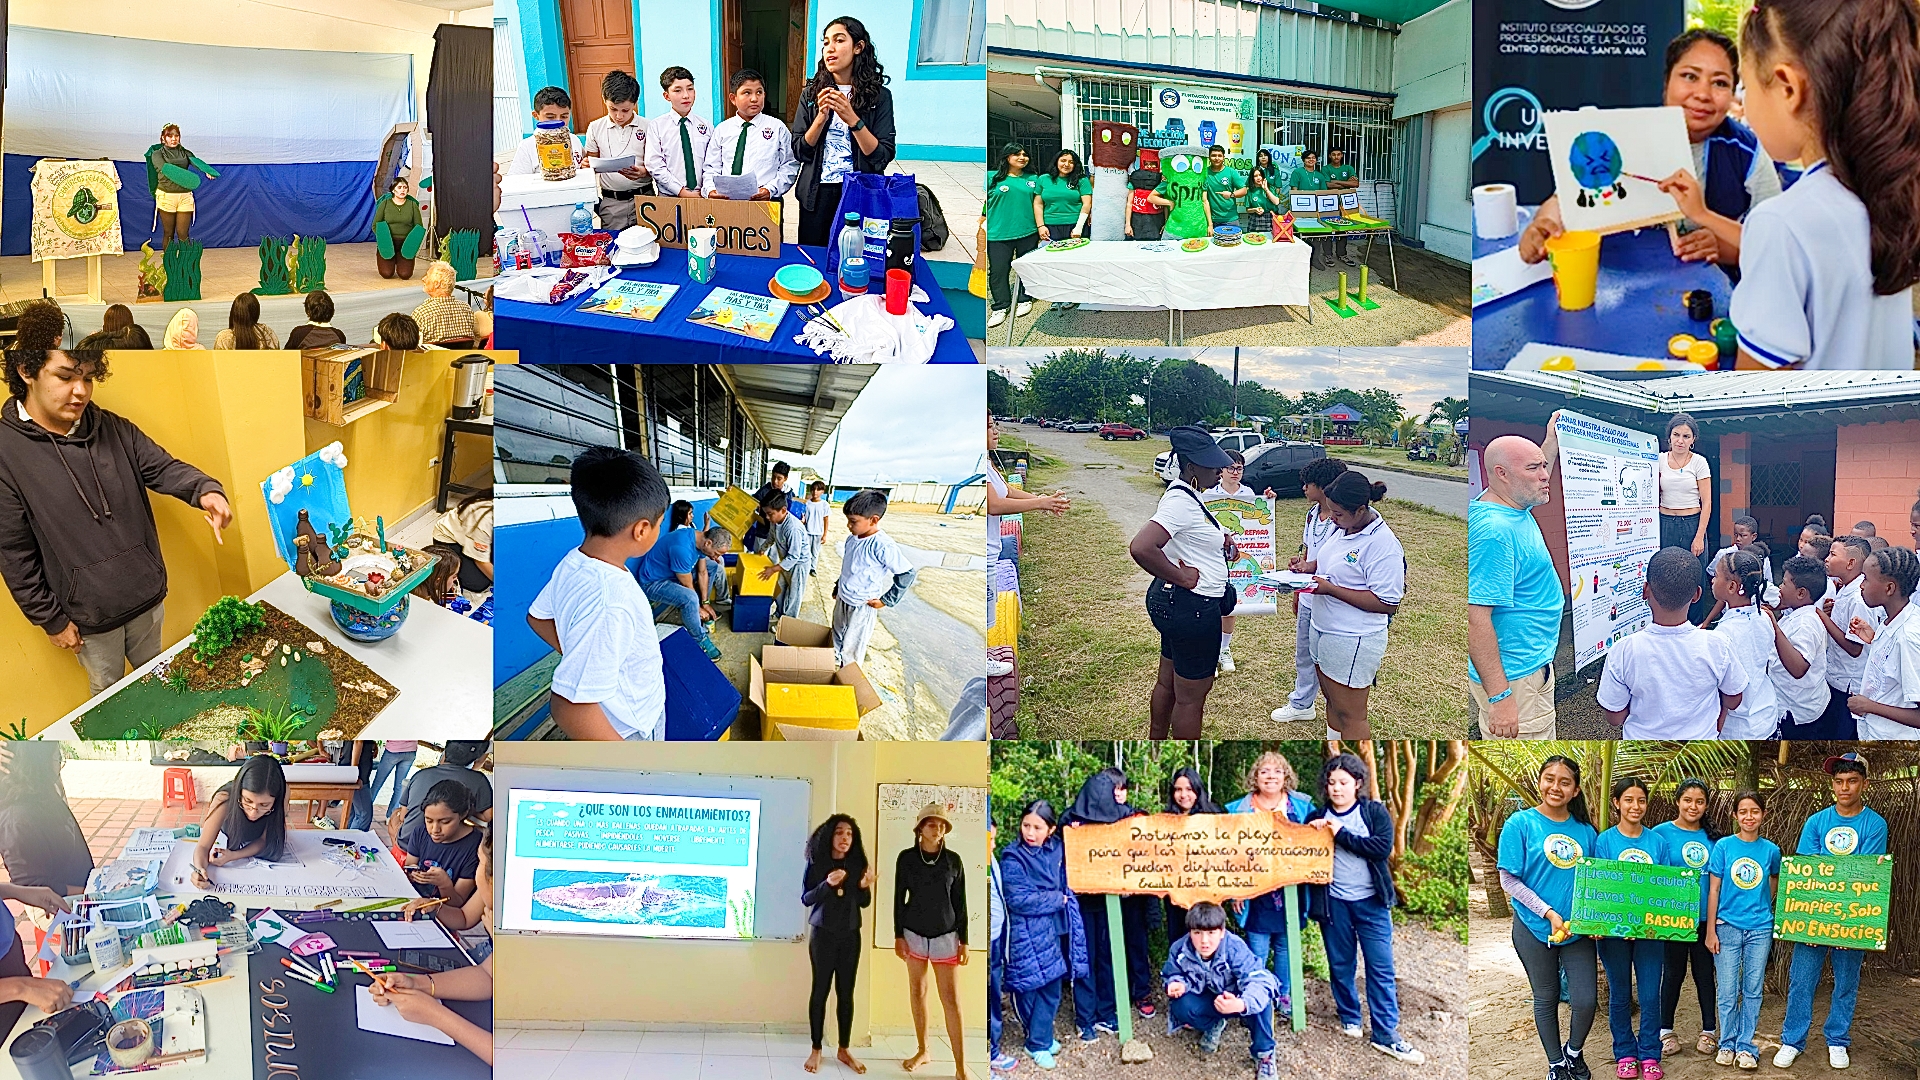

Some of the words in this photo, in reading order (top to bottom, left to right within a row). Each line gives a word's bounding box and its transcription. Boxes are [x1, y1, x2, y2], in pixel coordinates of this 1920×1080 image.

[1500, 23, 1548, 33] INSTITUTO
[1550, 23, 1630, 34] ESPECIALIZADO
[1632, 25, 1647, 34] DE
[1500, 33, 1580, 44] PROFESIONALES
[1582, 35, 1596, 44] DE
[1599, 36, 1611, 44] LA
[1613, 36, 1647, 45] SALUD
[1500, 44, 1538, 53] CENTRO
[1540, 45, 1589, 54] REGIONAL
[1591, 46, 1621, 55] SANTA
[1624, 47, 1647, 56] ANA
[1557, 423, 1586, 436] PROTEGER
[1578, 420, 1601, 432] NUESTRA
[579, 803, 604, 818] ¿QUE
[609, 804, 629, 816] SON
[633, 805, 652, 817] LOS
[546, 819, 570, 827] CUANDO
[574, 820, 585, 828] UNA
[611, 821, 641, 830] BALLENAS
[643, 823, 667, 831] QUEDAN
[670, 824, 705, 833] ATRAPADAS
[707, 825, 715, 833] EN
[718, 826, 736, 834] ARTES
[535, 829, 554, 837] PESCA
[653, 834, 681, 842] MOVERSE
[690, 836, 725, 844] LIBREMENTE
[1215, 827, 1231, 840] la
[1238, 827, 1282, 845] playa
[577, 841, 606, 850] PUDIENDO
[608, 843, 641, 852] CAUSARLES
[1088, 848, 1121, 863] para
[1127, 848, 1150, 862] que
[1155, 844, 1176, 856] las
[1185, 844, 1238, 861] futuras
[1245, 844, 1330, 861] generaciones
[1123, 859, 1173, 879] puedan
[1818, 862, 1835, 876] te
[1138, 877, 1174, 889] Escuela
[1631, 871, 1644, 884] tu
[1650, 875, 1696, 889] celular?
[1785, 878, 1846, 895] pedimos
[1851, 881, 1880, 897] que
[1629, 893, 1644, 905] tu
[1848, 902, 1883, 918] Solo
[1628, 912, 1641, 924] tu
